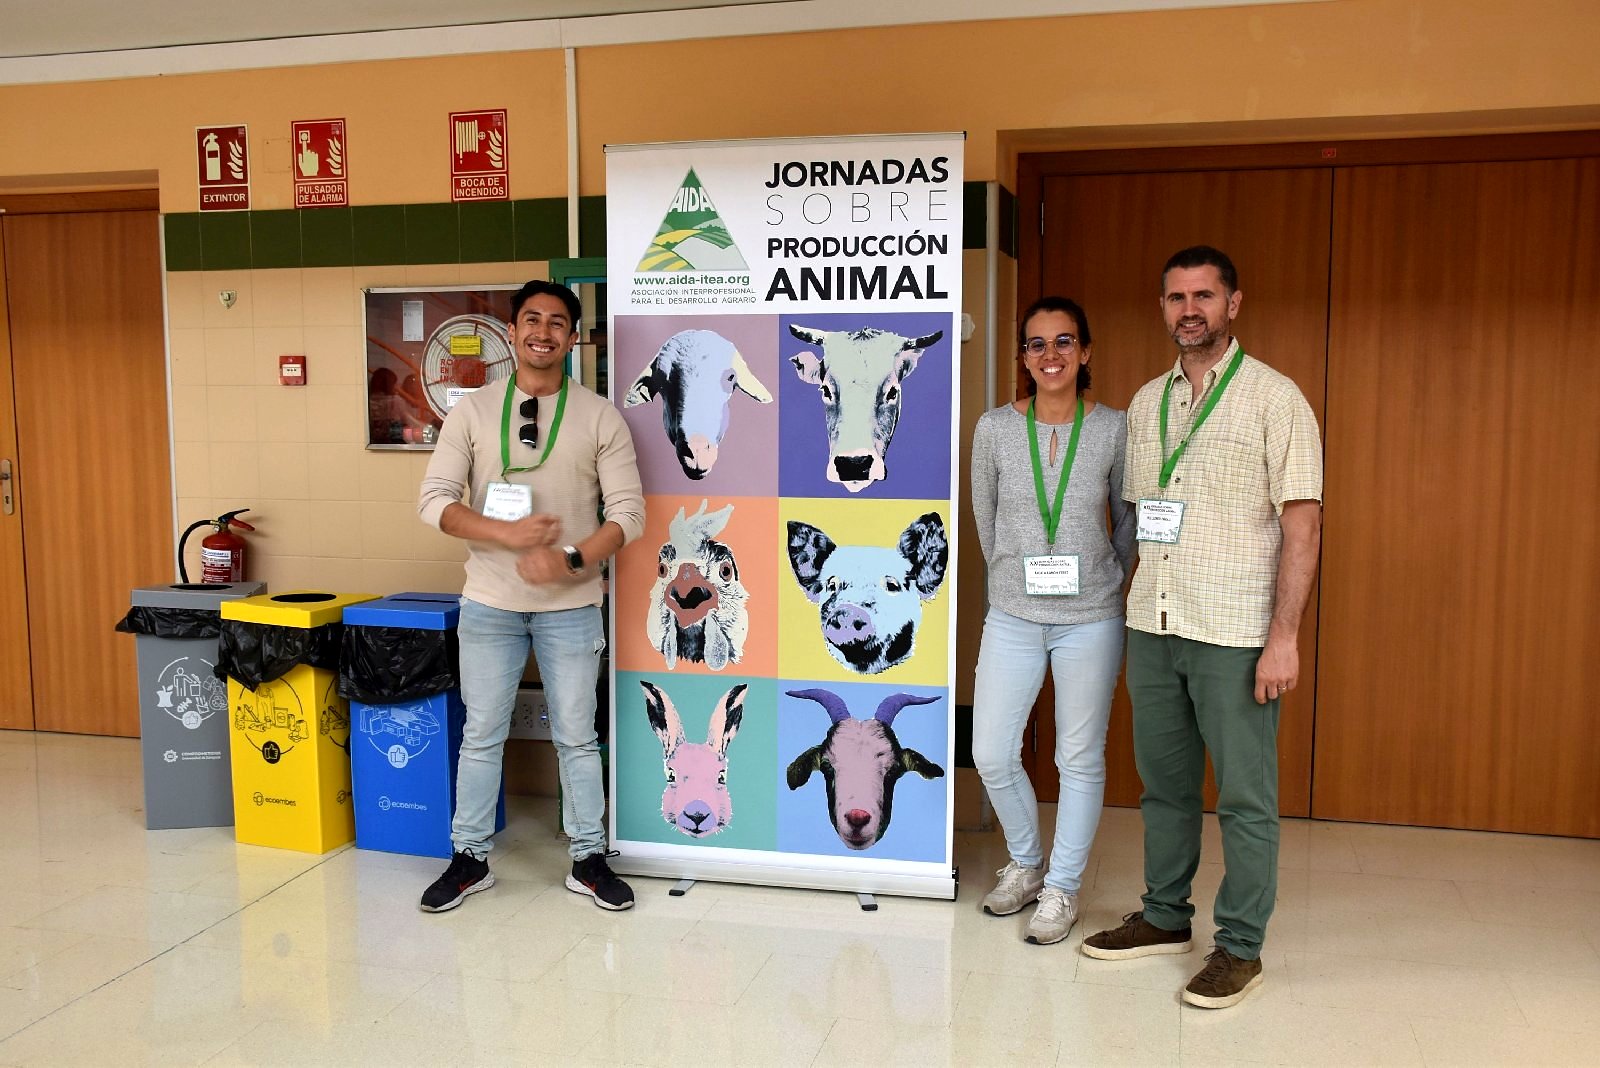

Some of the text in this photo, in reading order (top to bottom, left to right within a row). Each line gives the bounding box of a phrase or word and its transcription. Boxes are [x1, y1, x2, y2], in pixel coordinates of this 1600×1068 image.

[765, 156, 949, 188] JORNADAS
[460, 177, 500, 188] BOCA DE
[299, 184, 343, 194] PULSADOR
[456, 186, 504, 197] INCENDIOS
[203, 193, 246, 203] EXTINTOR
[299, 193, 344, 203] DE ALARMA
[667, 186, 717, 213] AIDA
[766, 190, 948, 226] SOBRE
[767, 229, 948, 258] PRODUCCIÓN
[633, 274, 750, 286] www.aida-itea.org
[765, 265, 949, 301] ANIMAL
[631, 287, 757, 296] ASOCIACIÓN INTERPROFESIONAL
[631, 297, 652, 305] PARA
[668, 297, 718, 305] DESARROLLO
[721, 296, 757, 304] AGRARIO
